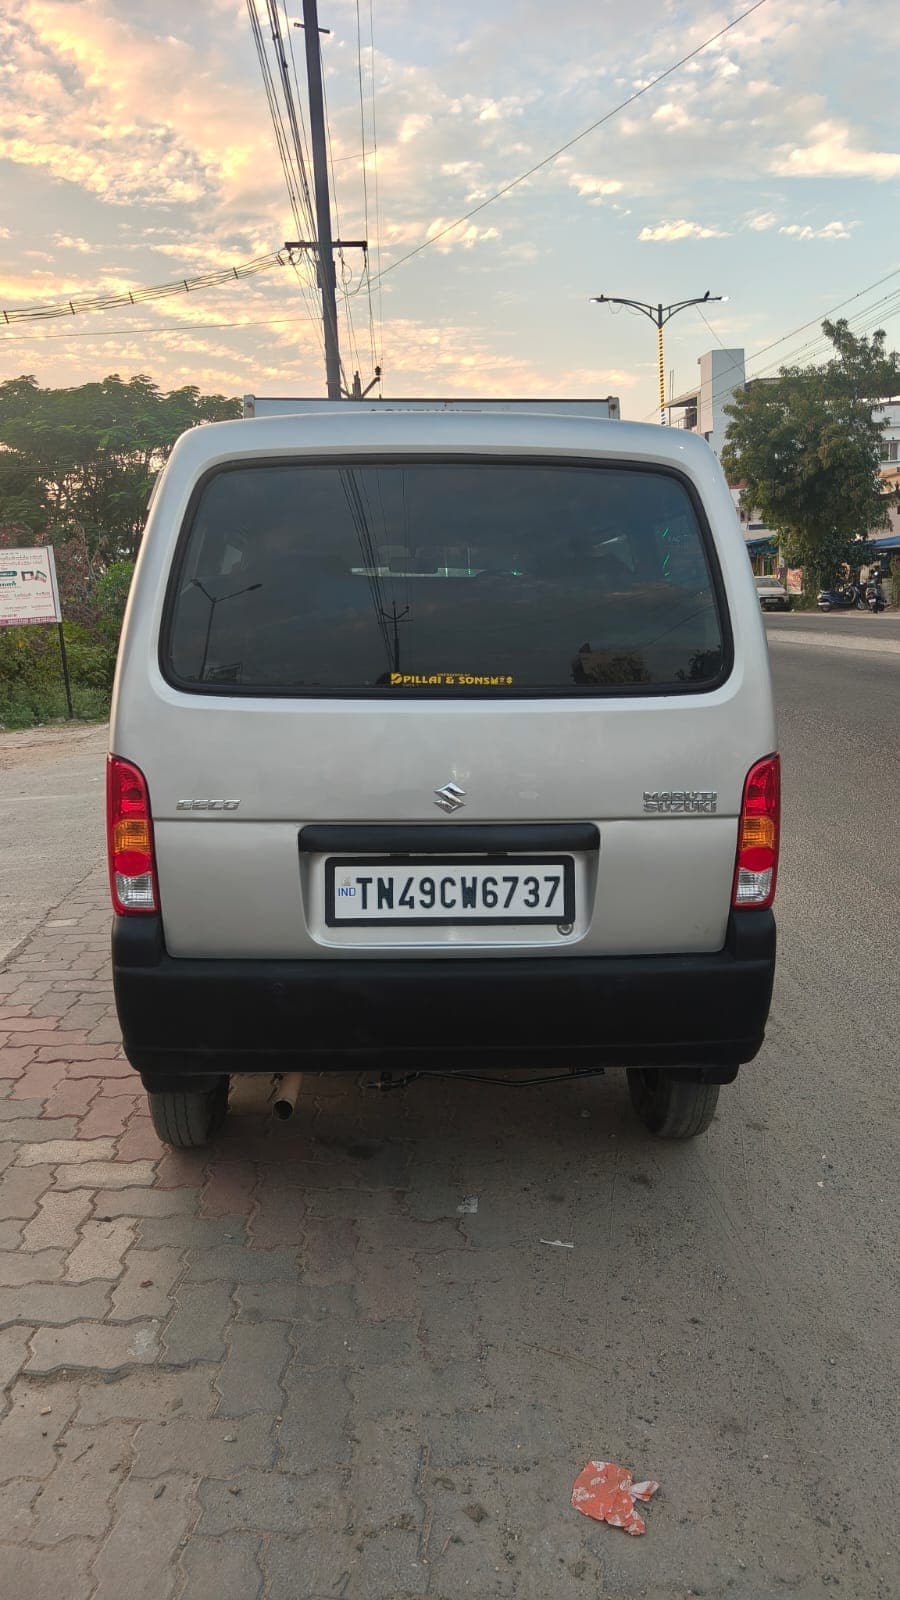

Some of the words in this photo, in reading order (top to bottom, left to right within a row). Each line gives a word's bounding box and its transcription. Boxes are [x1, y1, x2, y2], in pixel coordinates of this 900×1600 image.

[403, 675, 441, 685] PILLAI
[445, 676, 454, 685] &
[458, 676, 490, 685] SONS
[643, 791, 718, 801] MARUTI
[643, 801, 718, 813] SUZUKI
[338, 887, 356, 897] IND
[356, 876, 561, 910] TN49CW6737
